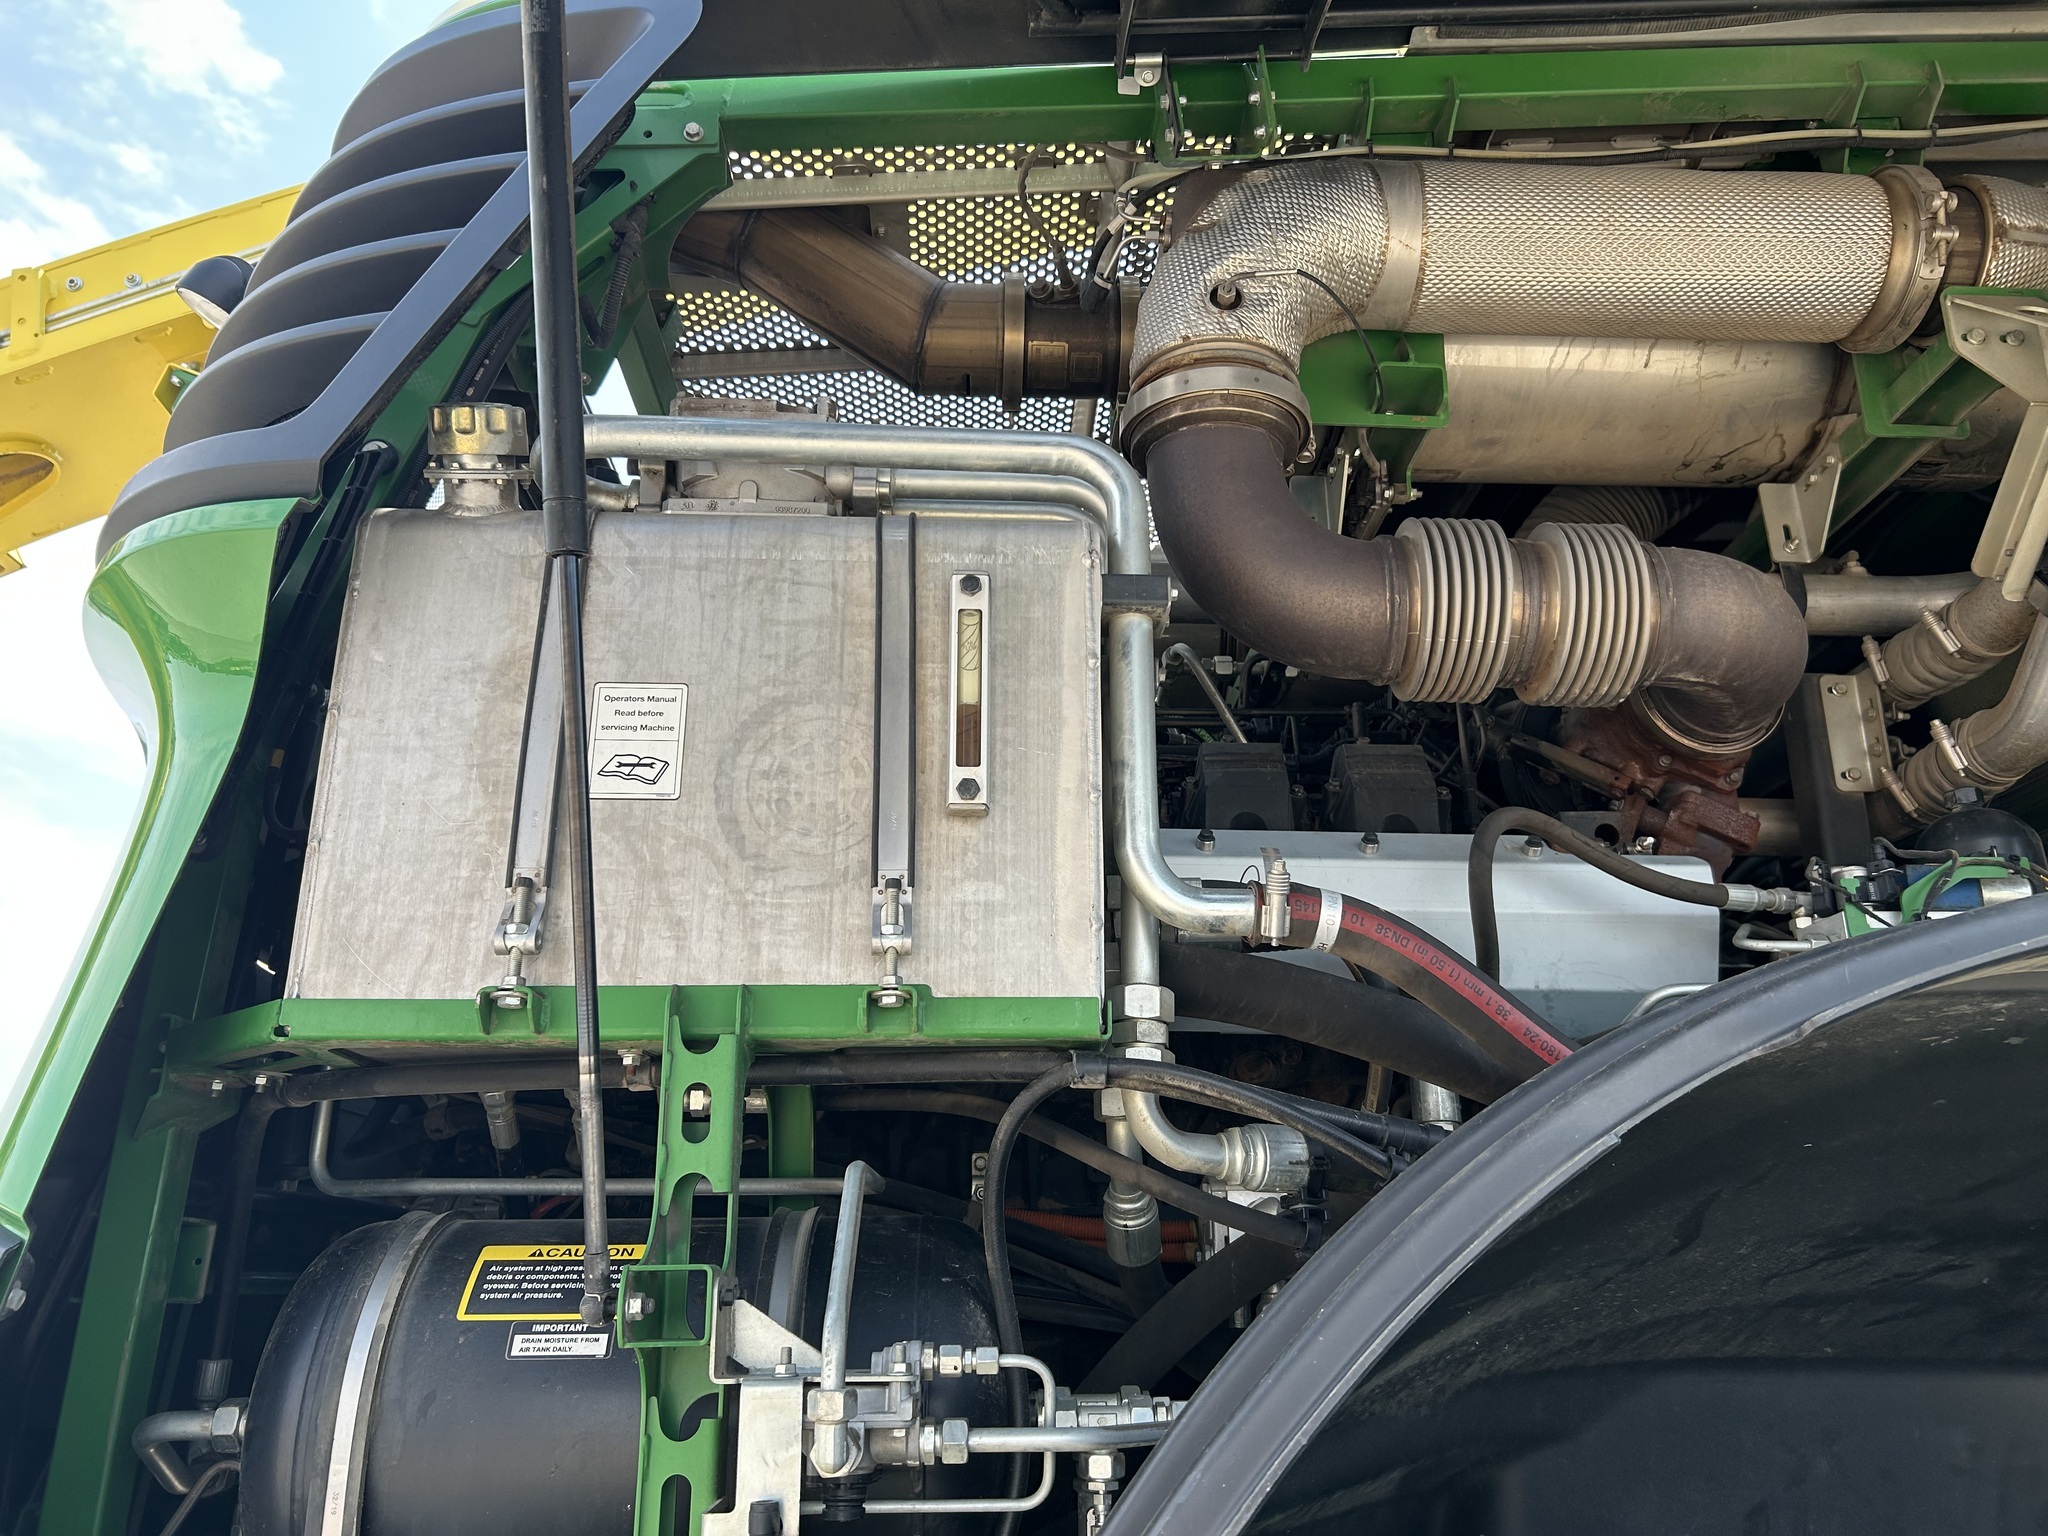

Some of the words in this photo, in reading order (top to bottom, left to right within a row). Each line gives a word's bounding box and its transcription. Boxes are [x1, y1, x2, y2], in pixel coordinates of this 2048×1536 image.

[604, 695, 645, 703] Operators
[614, 709, 636, 717] Read
[638, 709, 664, 717] before
[601, 724, 638, 732] servicing
[1295, 899, 1316, 914] 145
[1350, 913, 1365, 927] 10
[1374, 923, 1410, 948] DN38
[1412, 942, 1429, 960] in)
[1430, 955, 1460, 982] (1.50
[1463, 977, 1485, 997] mm
[1485, 996, 1511, 1021] 38.1
[546, 1248, 635, 1258] CAUON
[503, 1265, 533, 1273] system
[525, 1273, 580, 1281] components.
[482, 1282, 519, 1290] eyewear.
[524, 1292, 564, 1300] pressure.
[531, 1324, 589, 1332] IMPORTANT
